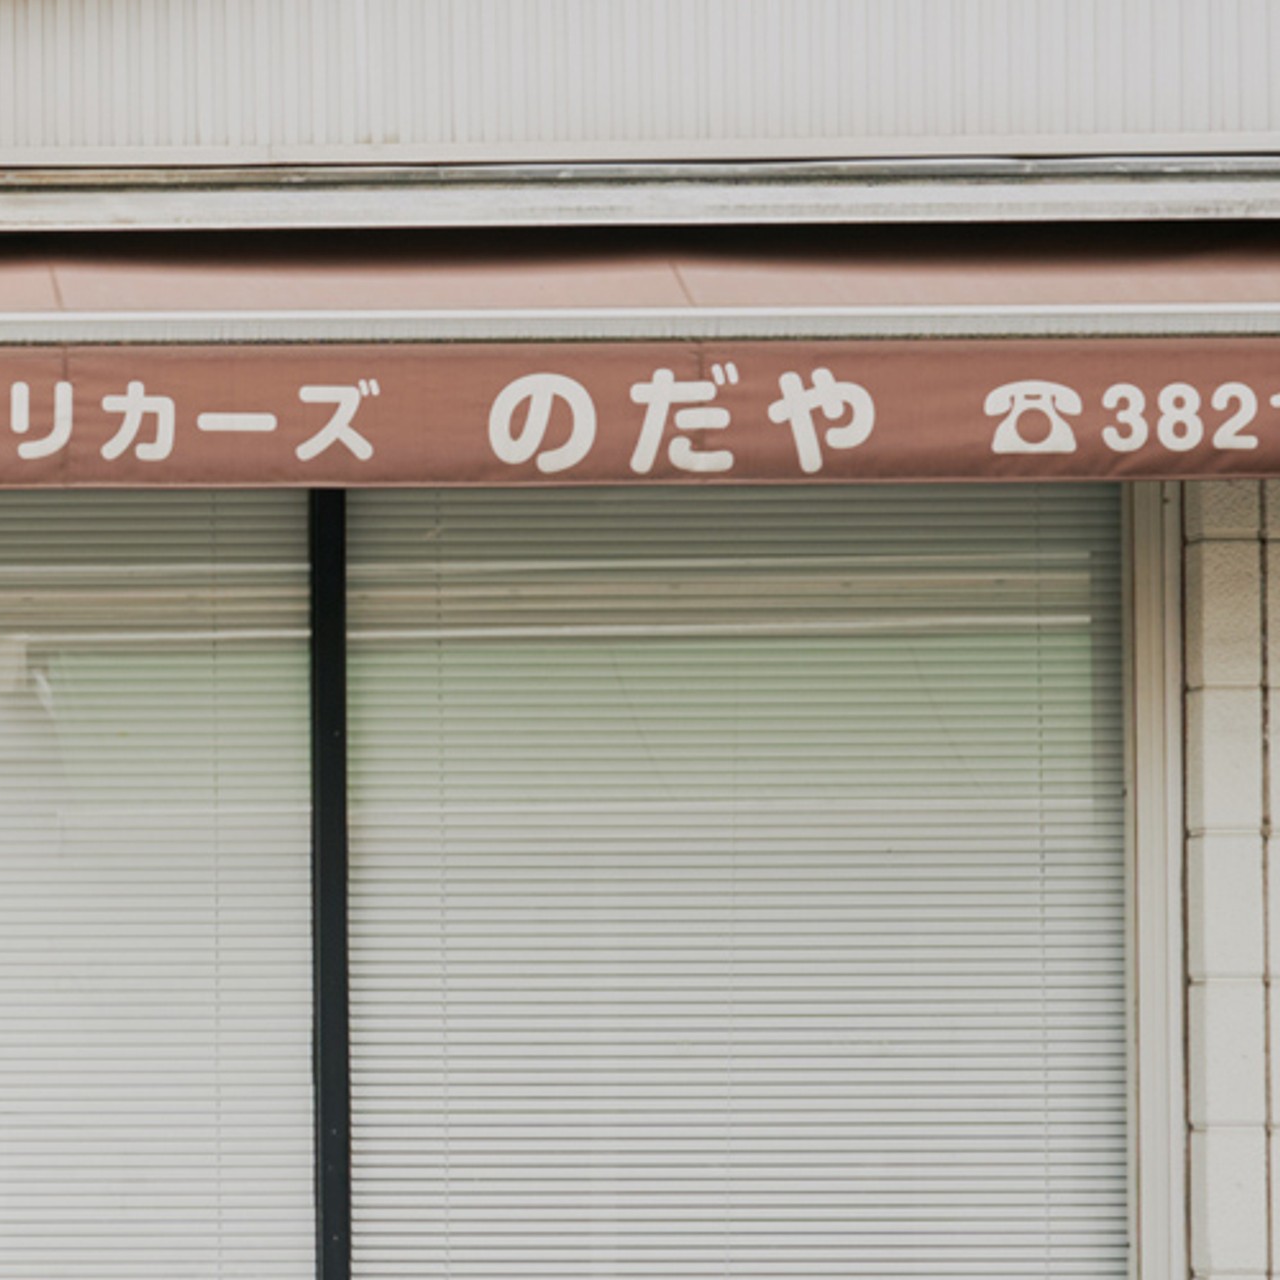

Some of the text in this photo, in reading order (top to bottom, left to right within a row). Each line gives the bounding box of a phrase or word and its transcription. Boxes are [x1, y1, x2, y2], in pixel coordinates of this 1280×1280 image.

[10, 361, 1280, 474] リカーズ のだや 382
